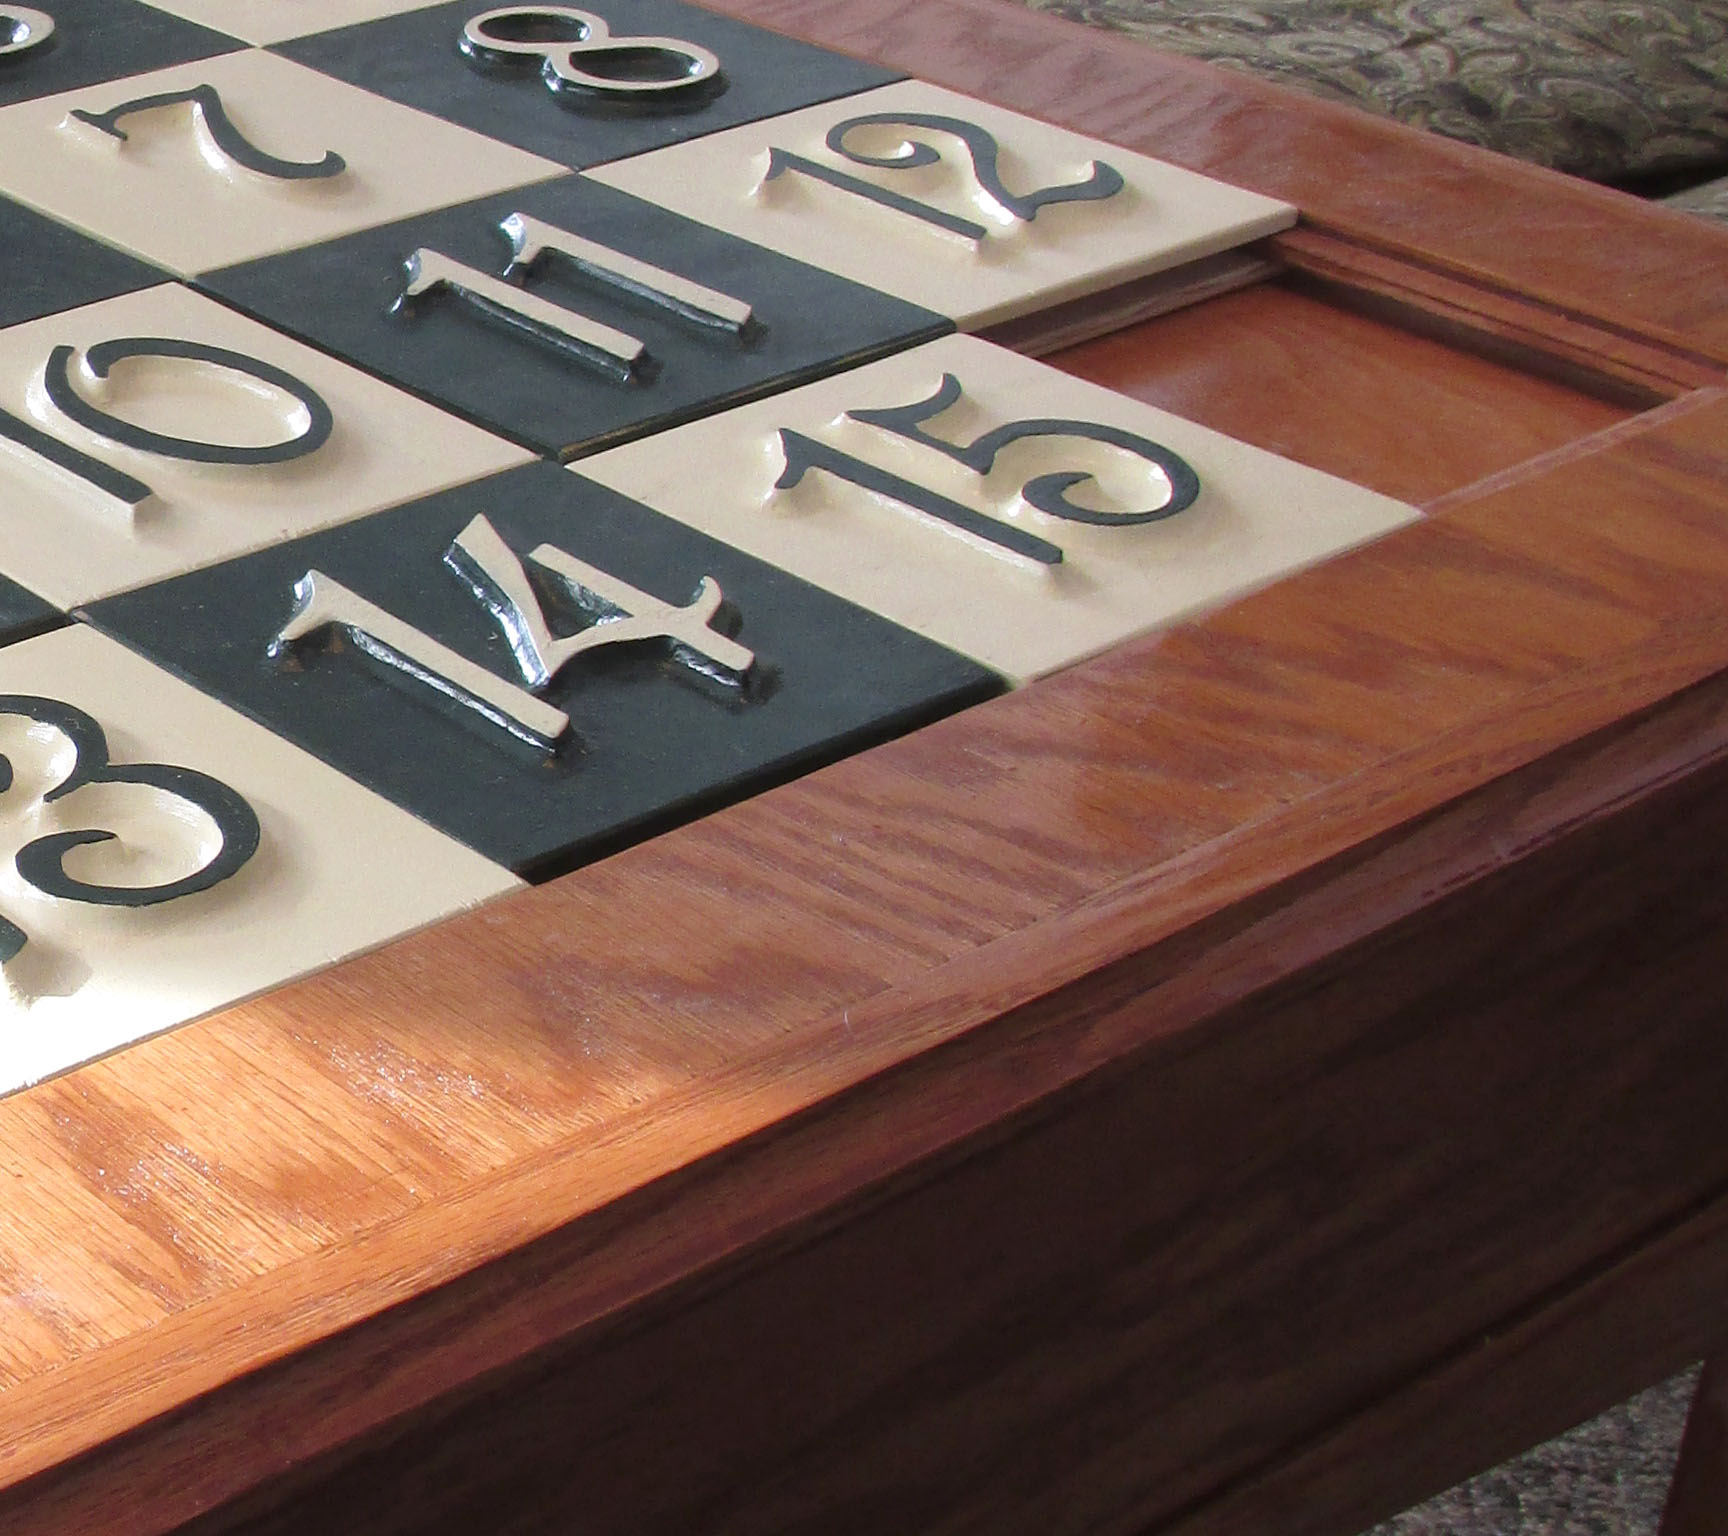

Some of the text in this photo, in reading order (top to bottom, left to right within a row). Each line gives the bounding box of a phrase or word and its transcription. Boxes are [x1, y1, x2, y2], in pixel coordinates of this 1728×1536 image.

[460, 5, 720, 95] 8
[63, 85, 347, 180] 7
[760, 112, 1126, 243] 12
[396, 211, 754, 379] 11
[776, 372, 1200, 566] 15
[275, 513, 754, 749] 14
